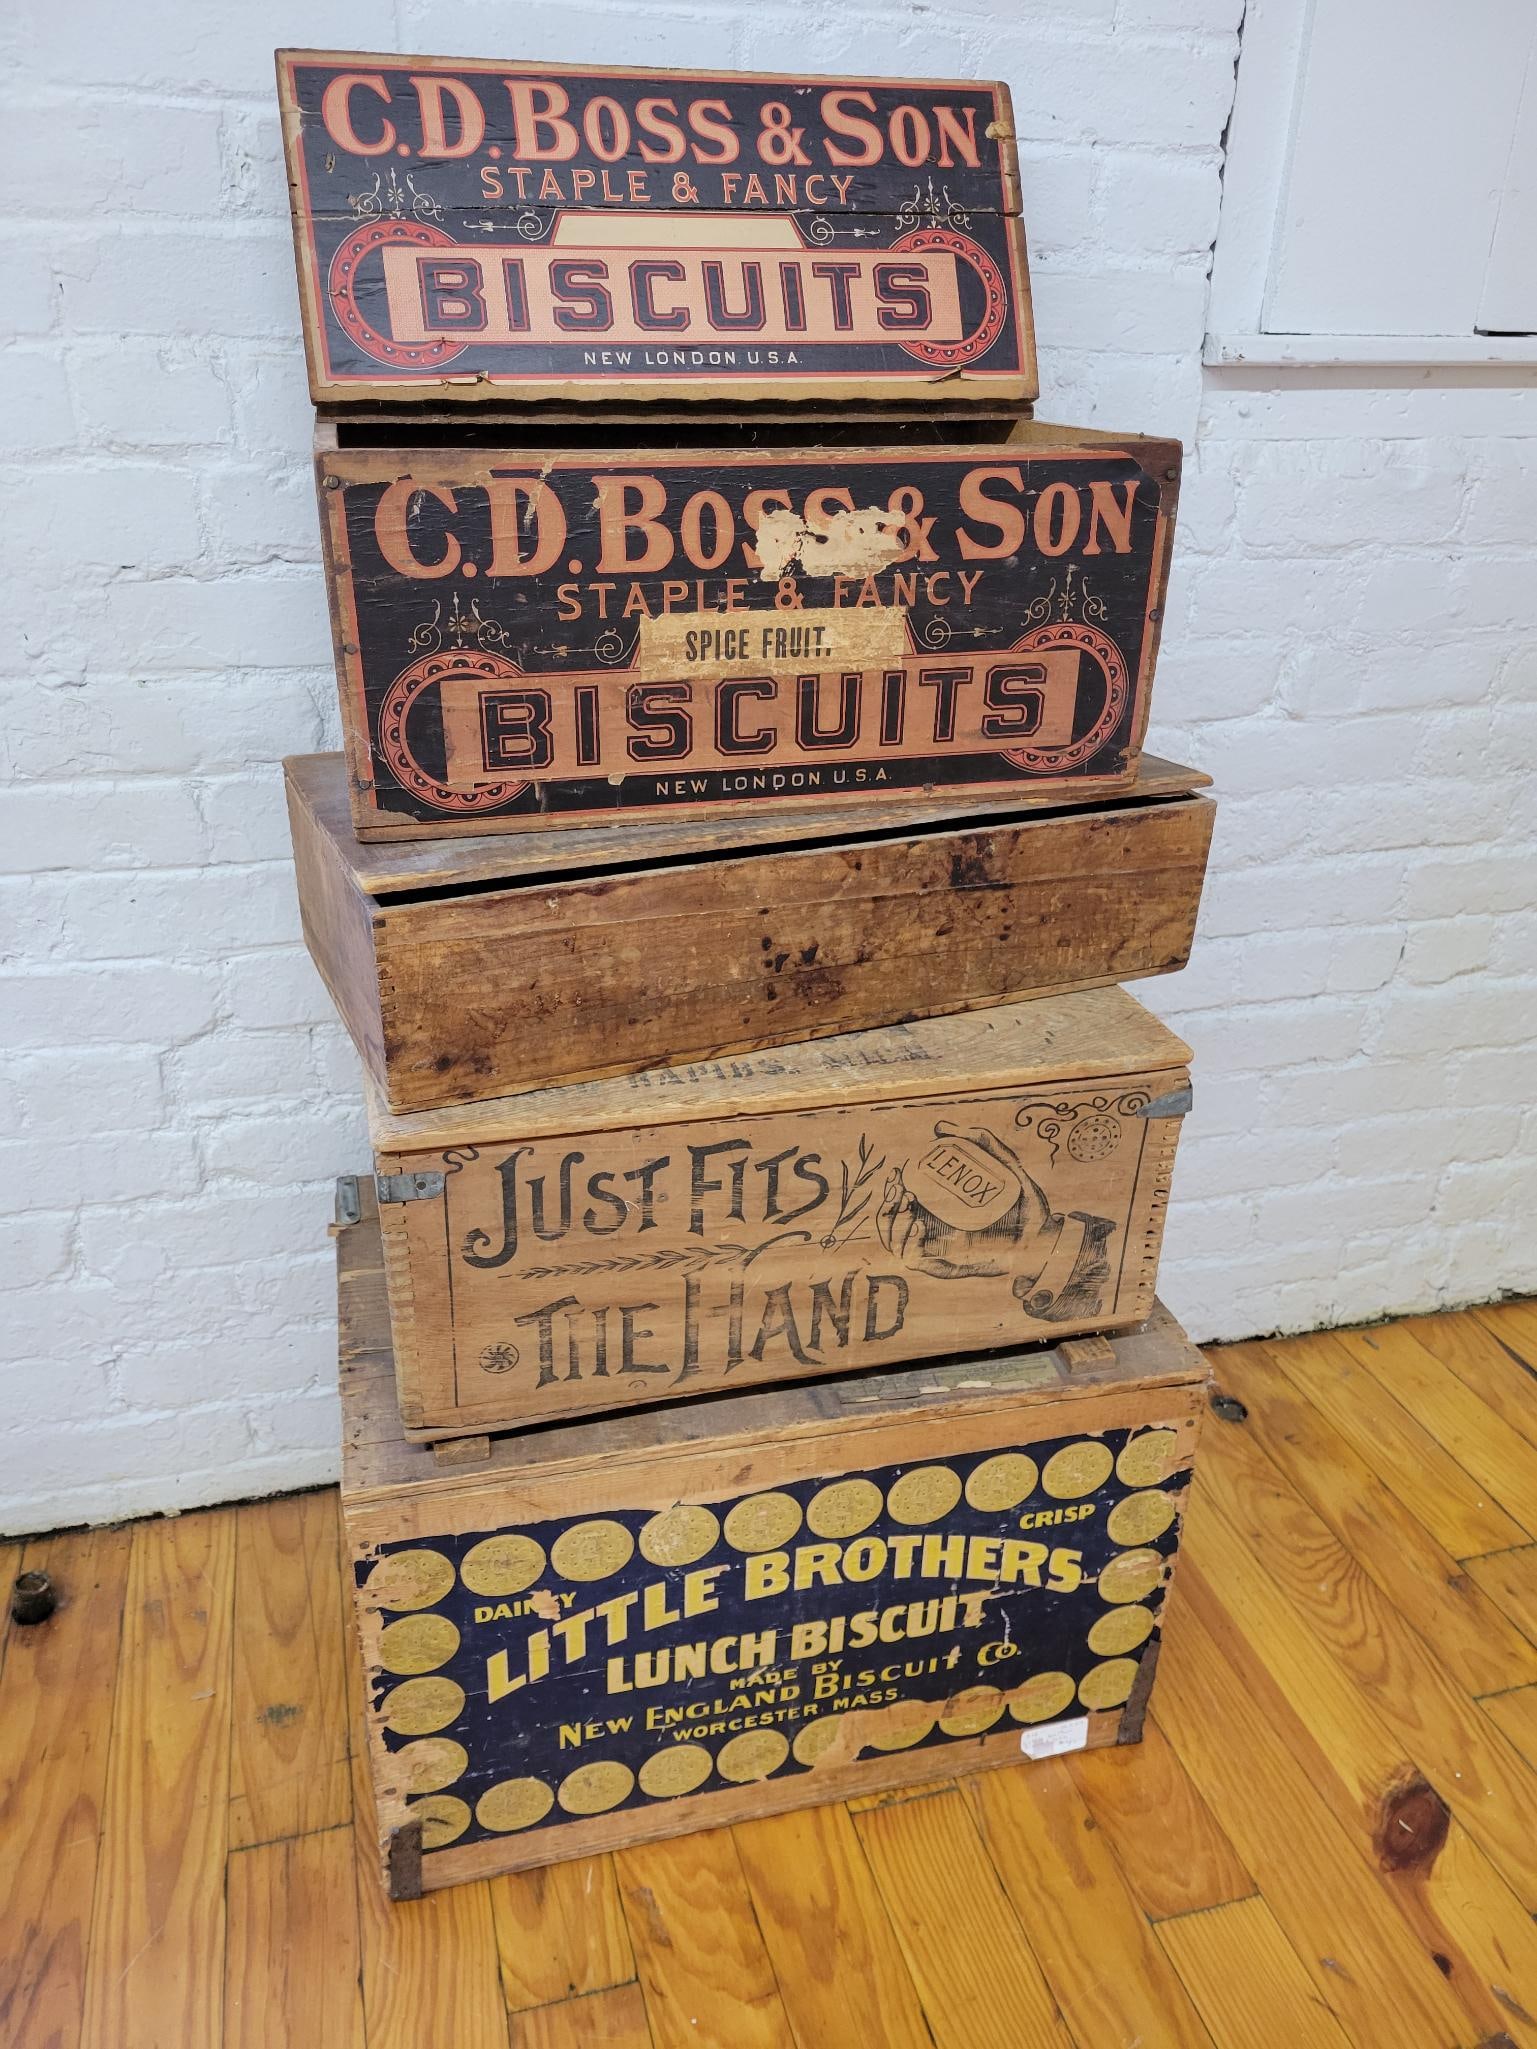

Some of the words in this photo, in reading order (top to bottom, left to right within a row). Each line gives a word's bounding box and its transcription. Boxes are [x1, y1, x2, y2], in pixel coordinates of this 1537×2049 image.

[757, 101, 812, 166] &
[820, 89, 983, 169] SON
[482, 167, 651, 201] STAPLE
[672, 169, 698, 202] &
[722, 171, 855, 206] FANCY
[415, 257, 935, 332] BISCUITS
[584, 351, 632, 365] NEW
[747, 351, 803, 364] U.S.A.
[875, 486, 940, 563] &
[957, 467, 1140, 560] SON
[557, 577, 751, 622] STAPLE
[774, 577, 805, 610] &
[833, 571, 985, 610] FANCY
[685, 629, 750, 661] SPICE
[481, 664, 1050, 772] BISCUITS
[656, 779, 708, 796] NEW
[833, 767, 893, 784] U.S.A.
[463, 1146, 671, 1268] JUST
[686, 1139, 831, 1237] FITS
[926, 1149, 997, 1203] LENOX
[513, 1296, 672, 1390] THE
[668, 1232, 912, 1386] HAND
[1019, 1503, 1097, 1530] CRISP
[474, 1591, 577, 1624] DAINY
[486, 1564, 731, 1704] LITTLE
[744, 1534, 1084, 1601] BROTHERS
[606, 1629, 777, 1695] LUNCH
[790, 1592, 986, 1661] BISCUIT
[729, 1668, 798, 1691] MADE
[811, 1659, 844, 1675] BY
[558, 1715, 636, 1751] NEW
[645, 1684, 801, 1731] ENGLAND
[813, 1645, 963, 1700] BISCUIT
